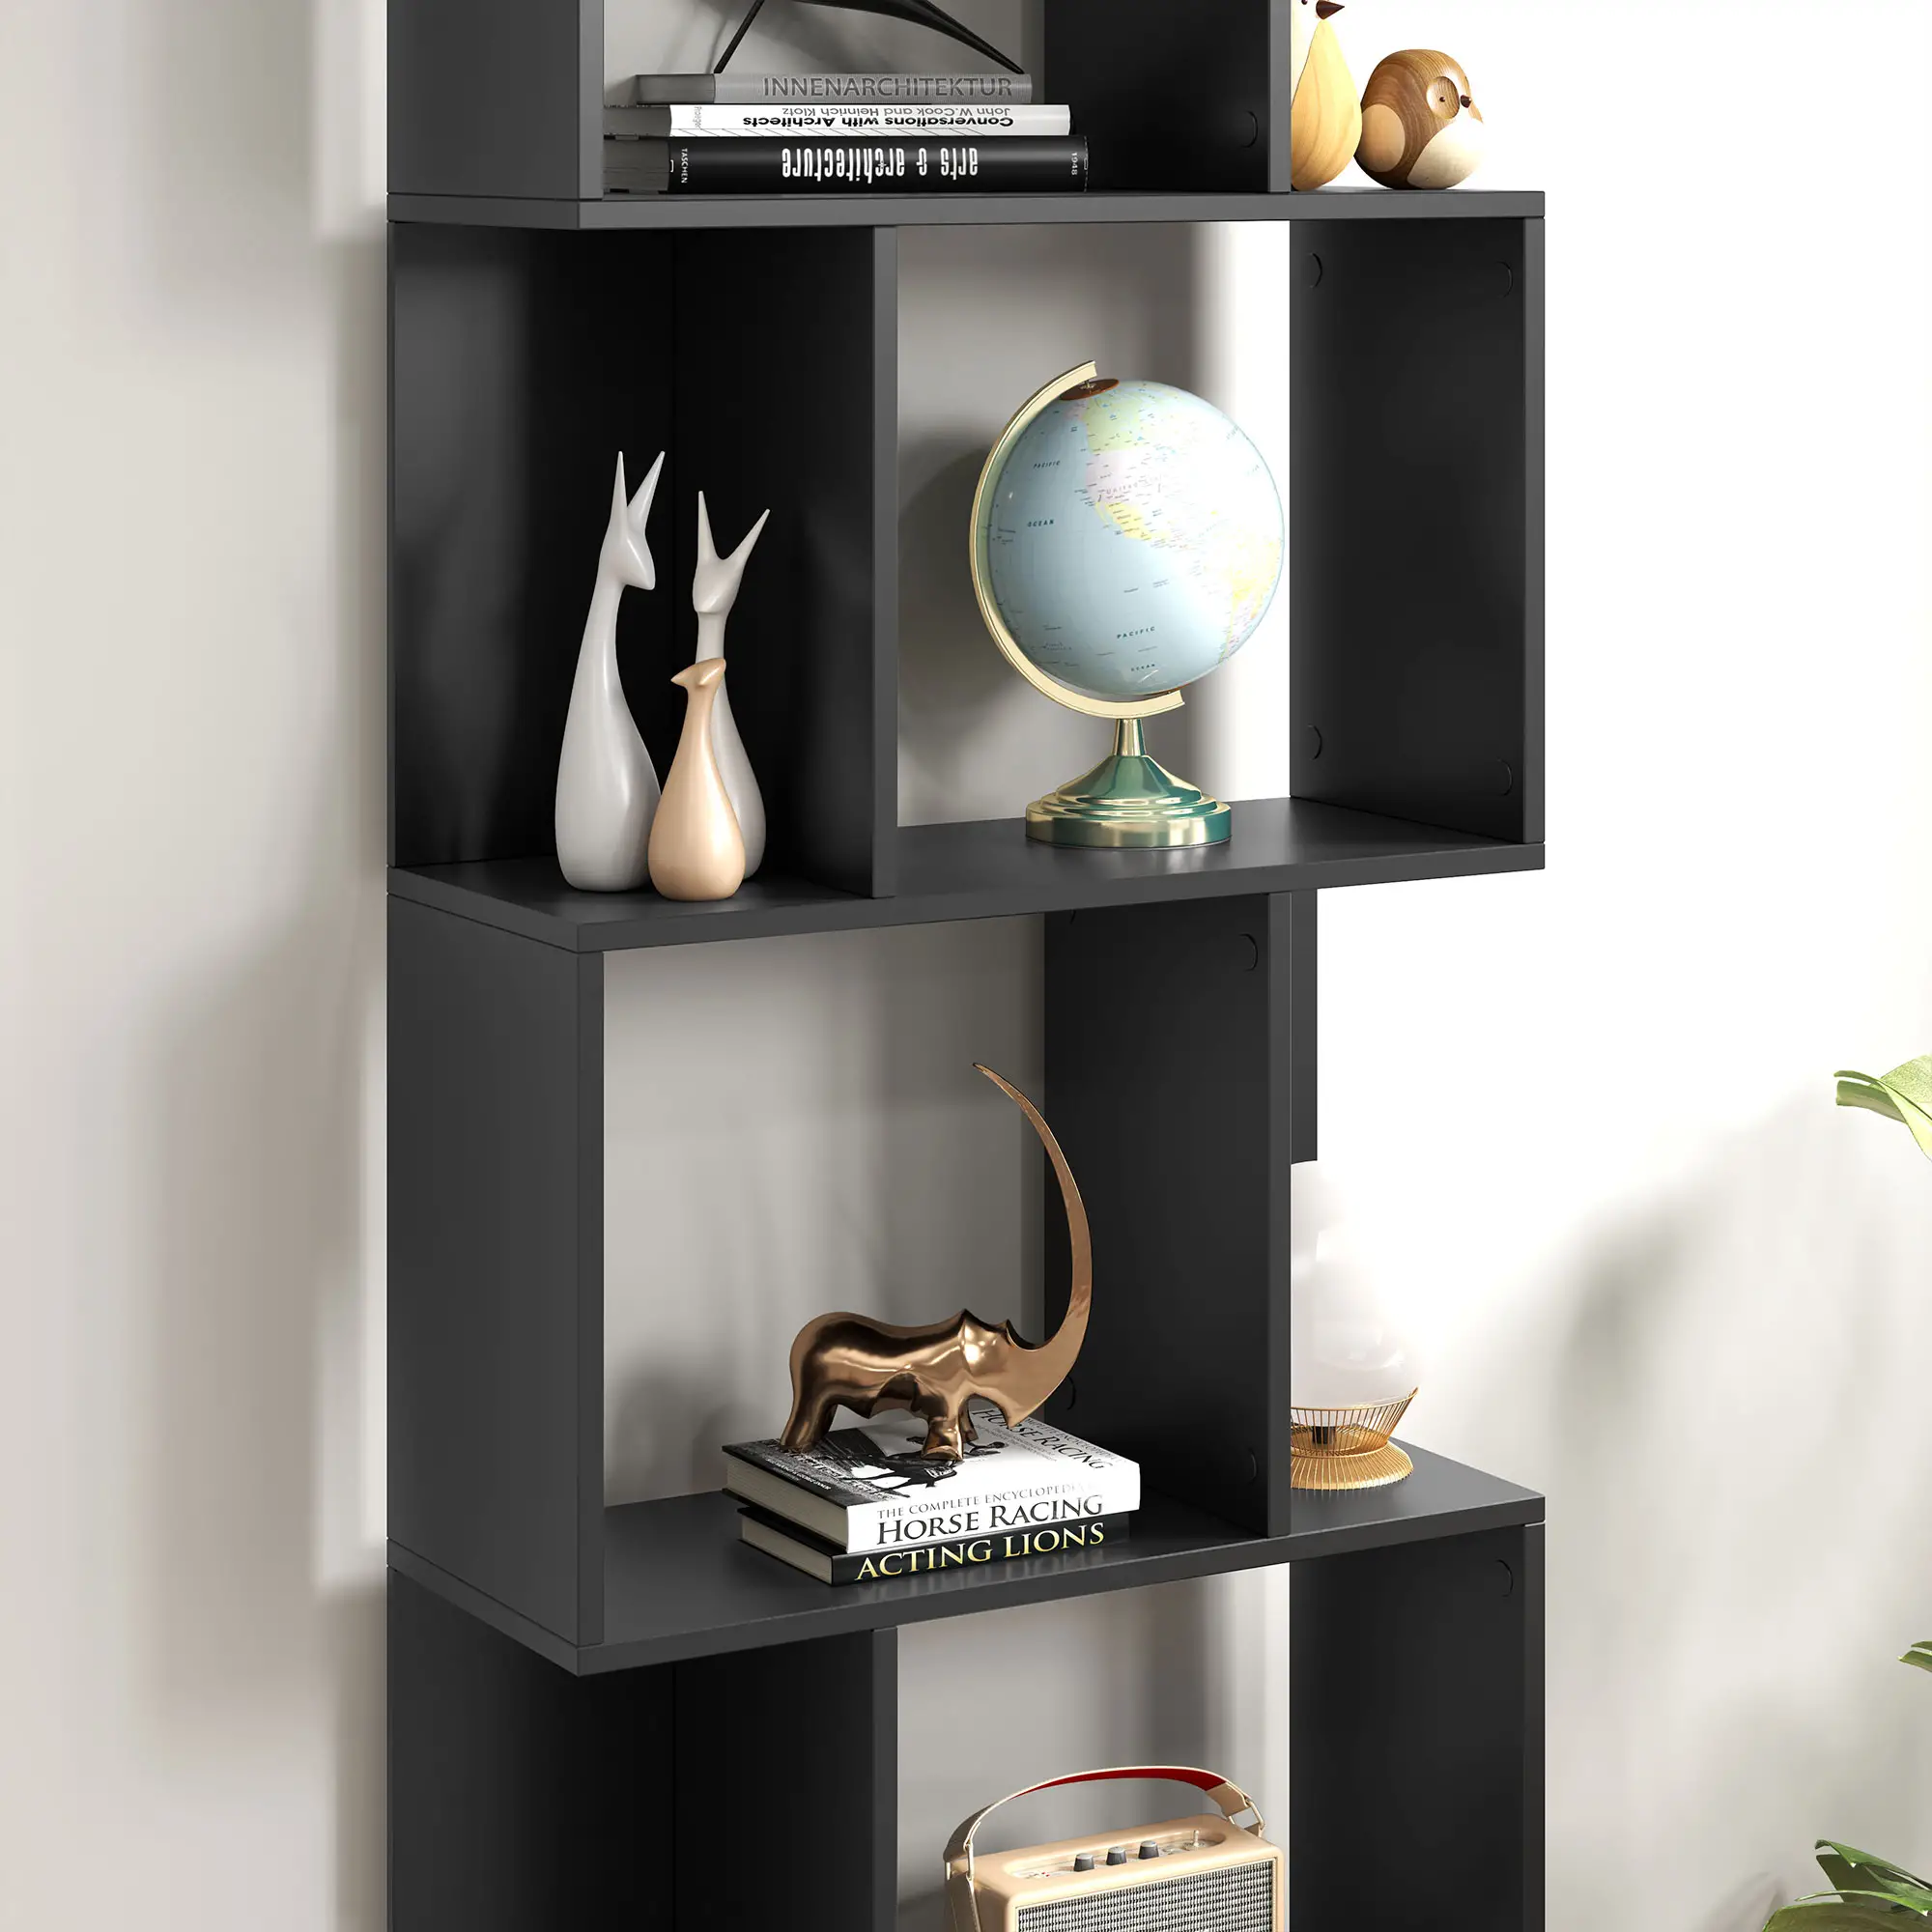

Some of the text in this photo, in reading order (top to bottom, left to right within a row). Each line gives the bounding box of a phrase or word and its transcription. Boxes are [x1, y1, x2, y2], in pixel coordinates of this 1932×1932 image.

[763, 77, 1012, 97] INNENARCHITEKTUR
[743, 117, 1014, 128] Conversations with Architects
[781, 148, 904, 183] architecture
[941, 148, 978, 180] arts
[1070, 152, 1079, 176] 1948
[1033, 461, 1061, 469] PACIFIC
[1027, 519, 1055, 527] OCEAN
[1117, 626, 1155, 639] PACIFIC
[1033, 1435, 1113, 1468] RACING
[876, 1494, 1104, 1546] HORSE RACING
[877, 1506, 904, 1520] THE
[909, 1497, 980, 1515] COMPLETE
[855, 1521, 1105, 1581] ACTING LIONS
